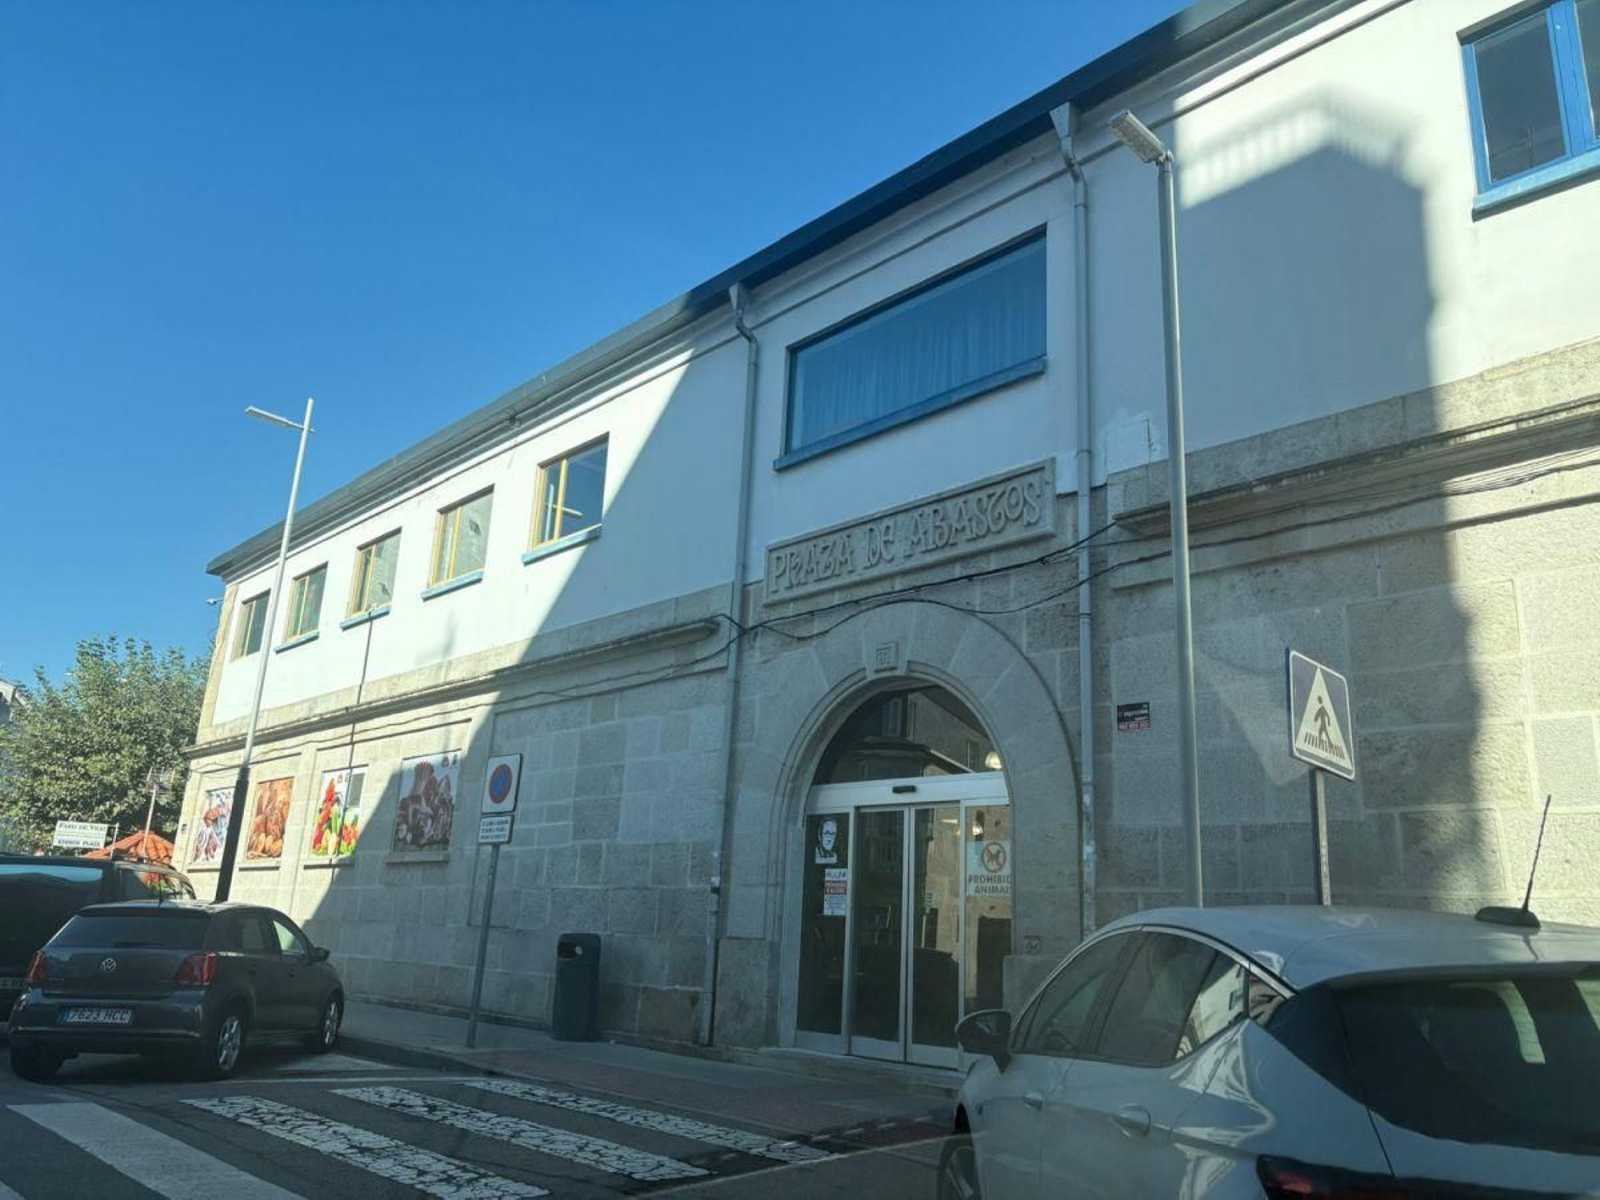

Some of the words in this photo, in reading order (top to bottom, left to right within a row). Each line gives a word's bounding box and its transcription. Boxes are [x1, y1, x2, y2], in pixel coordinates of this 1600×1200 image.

[771, 534, 853, 593] PRAZA
[863, 523, 895, 570] DE
[904, 480, 1042, 557] ABASTOS
